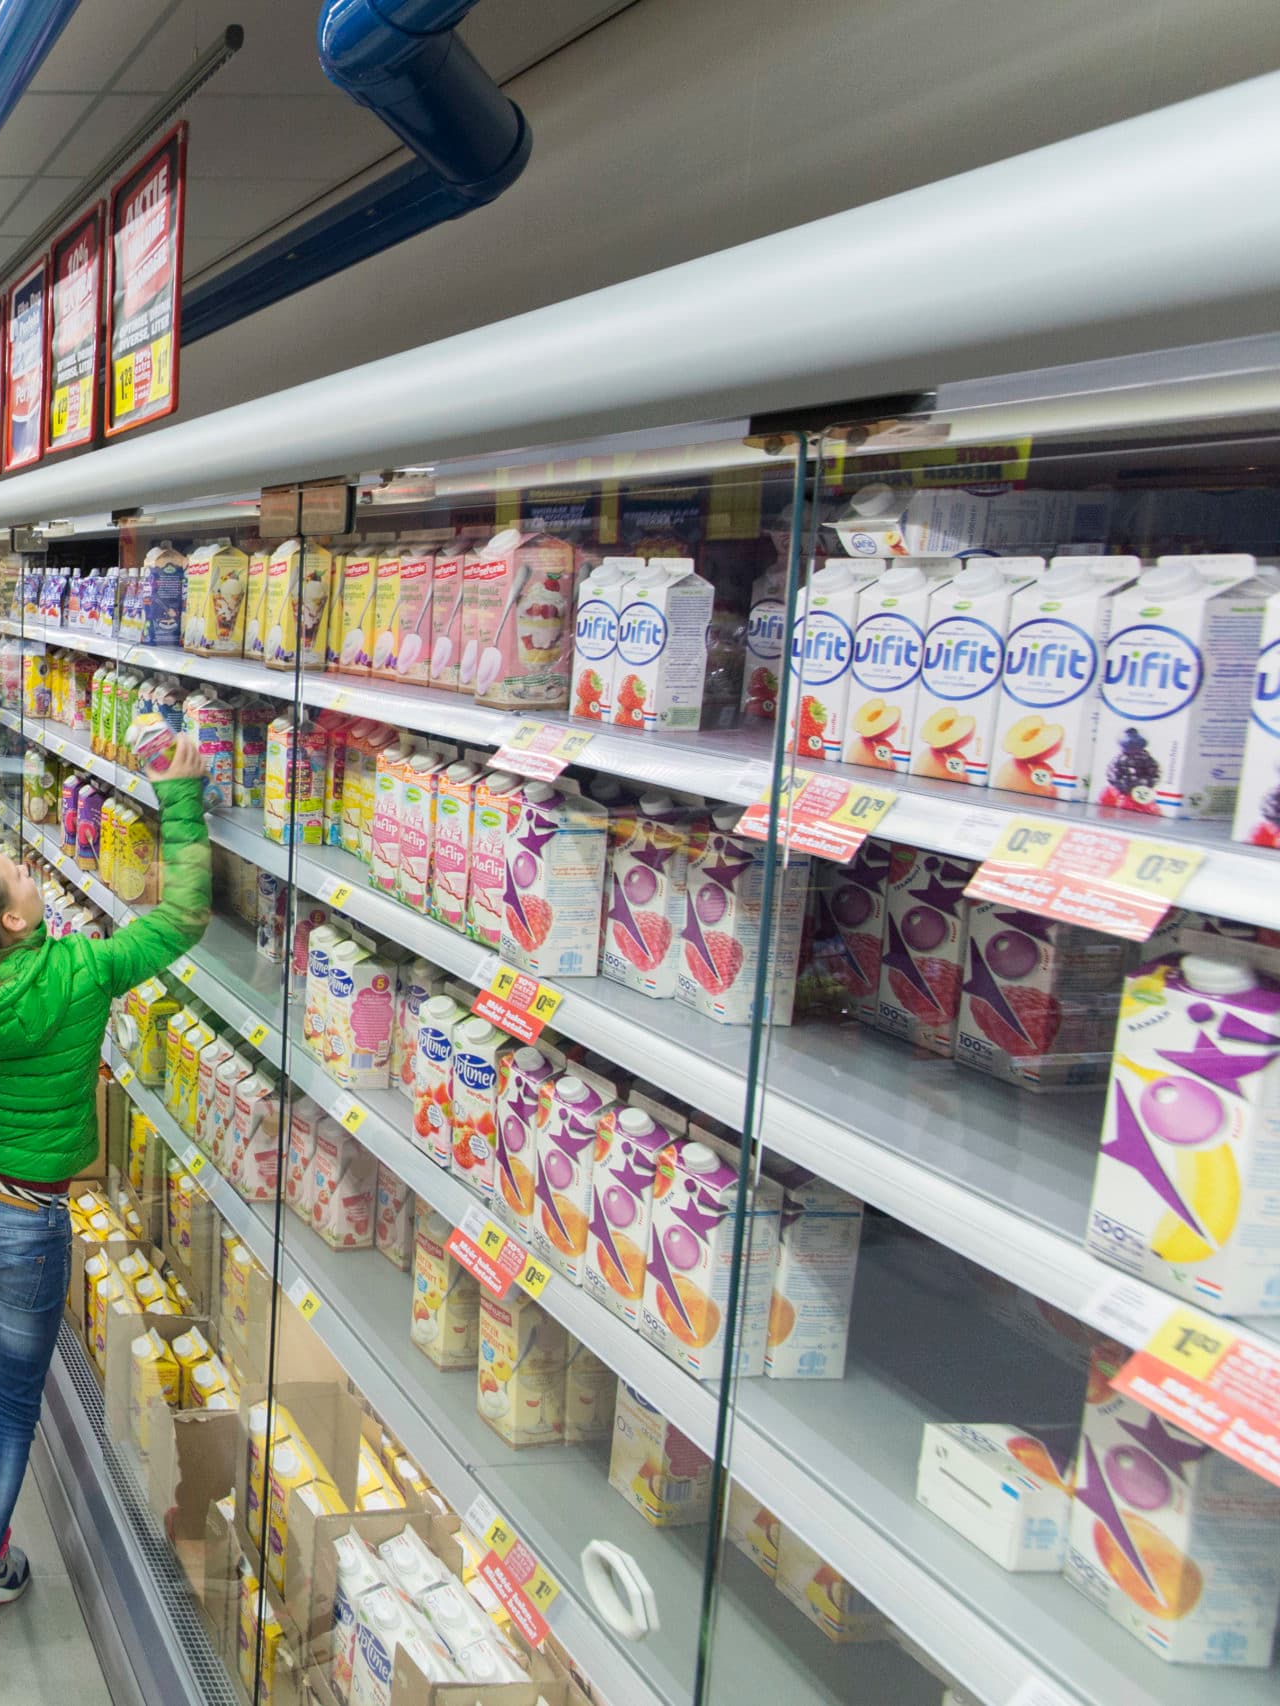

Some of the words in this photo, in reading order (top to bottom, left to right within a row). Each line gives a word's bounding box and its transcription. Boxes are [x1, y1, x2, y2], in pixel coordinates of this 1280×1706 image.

[126, 164, 168, 240] AKTIE
[577, 615, 617, 642] vifit
[619, 618, 662, 646] vifit
[748, 614, 785, 640] vifi
[791, 629, 848, 663] vifit
[853, 633, 920, 669] vifit
[924, 638, 1000, 674] vifit
[1006, 642, 1091, 681] vifit
[1102, 650, 1192, 691] vifit
[605, 954, 627, 970] 100%
[376, 977, 385, 989] 5
[678, 975, 697, 993] 100%
[879, 1004, 908, 1021] 100%
[502, 1018, 533, 1040] betalen!
[960, 1034, 992, 1053] 100%
[585, 1266, 606, 1291] 100%
[642, 1309, 667, 1337] 100%
